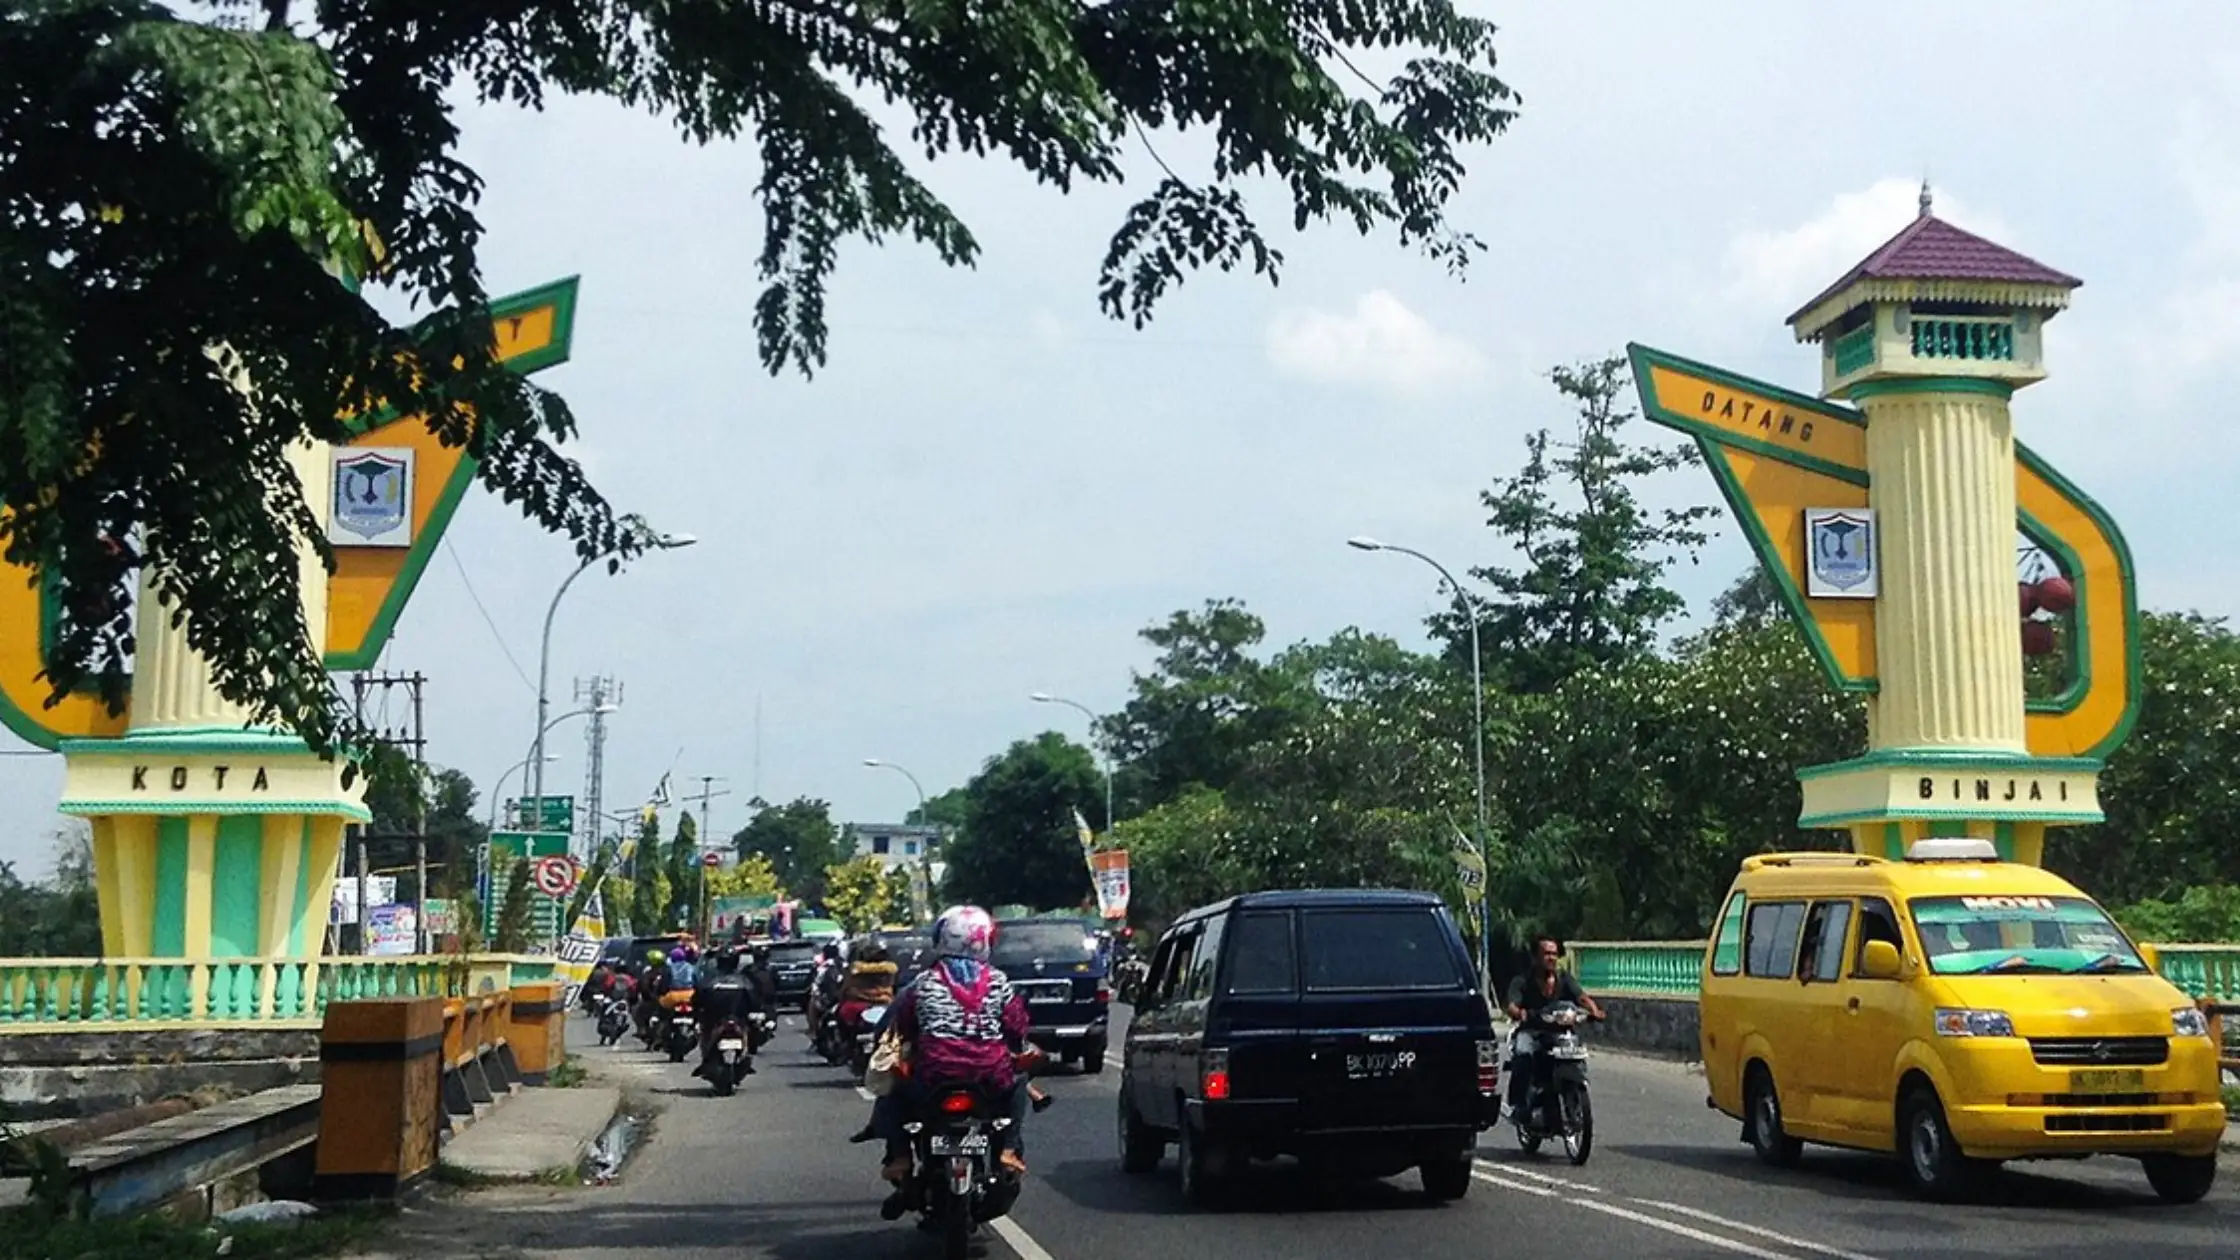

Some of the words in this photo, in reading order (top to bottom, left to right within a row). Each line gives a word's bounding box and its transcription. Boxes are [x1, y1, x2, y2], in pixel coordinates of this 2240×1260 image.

[1702, 390, 1813, 442] DATANG
[132, 765, 269, 791] KOTA
[1919, 777, 2068, 802] BINJAI
[1398, 1051, 1416, 1068] PP
